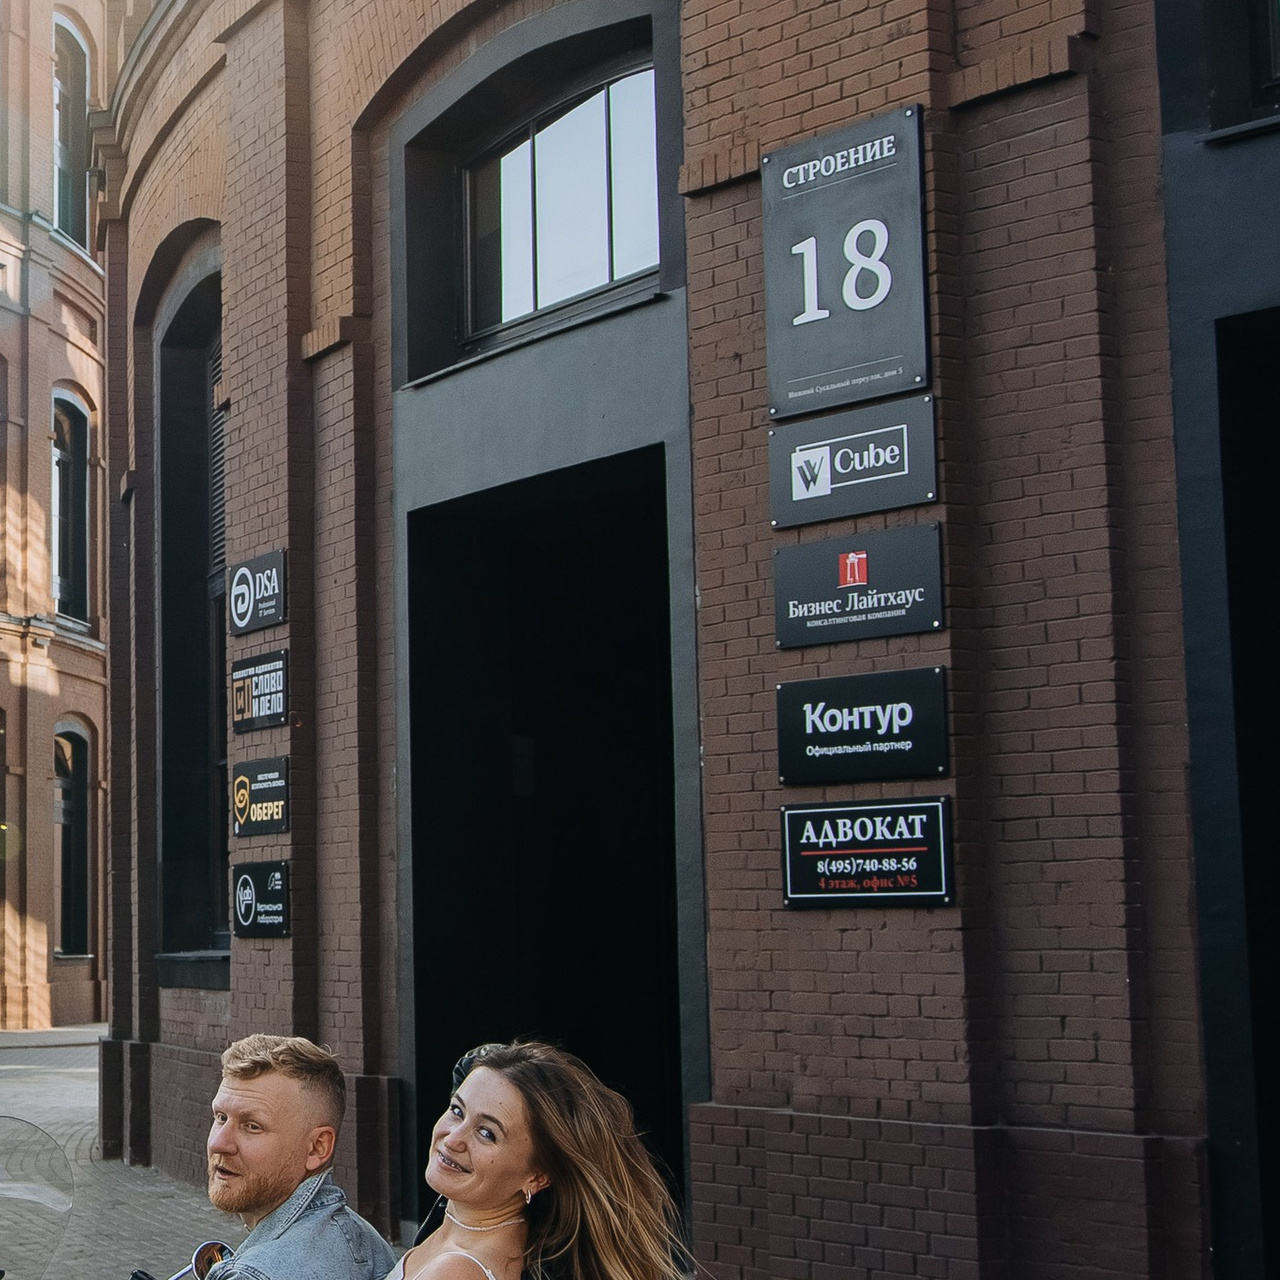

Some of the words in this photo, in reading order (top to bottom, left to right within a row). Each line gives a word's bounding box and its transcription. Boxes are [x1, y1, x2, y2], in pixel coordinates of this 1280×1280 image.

[782, 135, 897, 189] СТРОЕНИЕ
[791, 219, 893, 326] 18
[834, 443, 900, 473] Cube
[255, 568, 279, 599] DSA
[788, 599, 842, 618] Бизнес
[845, 588, 925, 611] Лайтхаус
[806, 612, 866, 627] консалтинговая
[867, 608, 906, 620] компания
[252, 670, 283, 696] СЛОВО
[252, 698, 258, 718] И
[259, 692, 283, 717] ДЕЛО
[802, 702, 913, 735] Контур
[806, 742, 872, 757] Официальный
[872, 740, 913, 753] партнер
[250, 800, 284, 821] ОБЕРЕГ
[800, 815, 927, 848] АДВОКАТ
[817, 857, 917, 876] 8(495)740-88-56
[818, 877, 826, 889] 4
[828, 878, 860, 891] этаж,
[863, 875, 894, 892] офис
